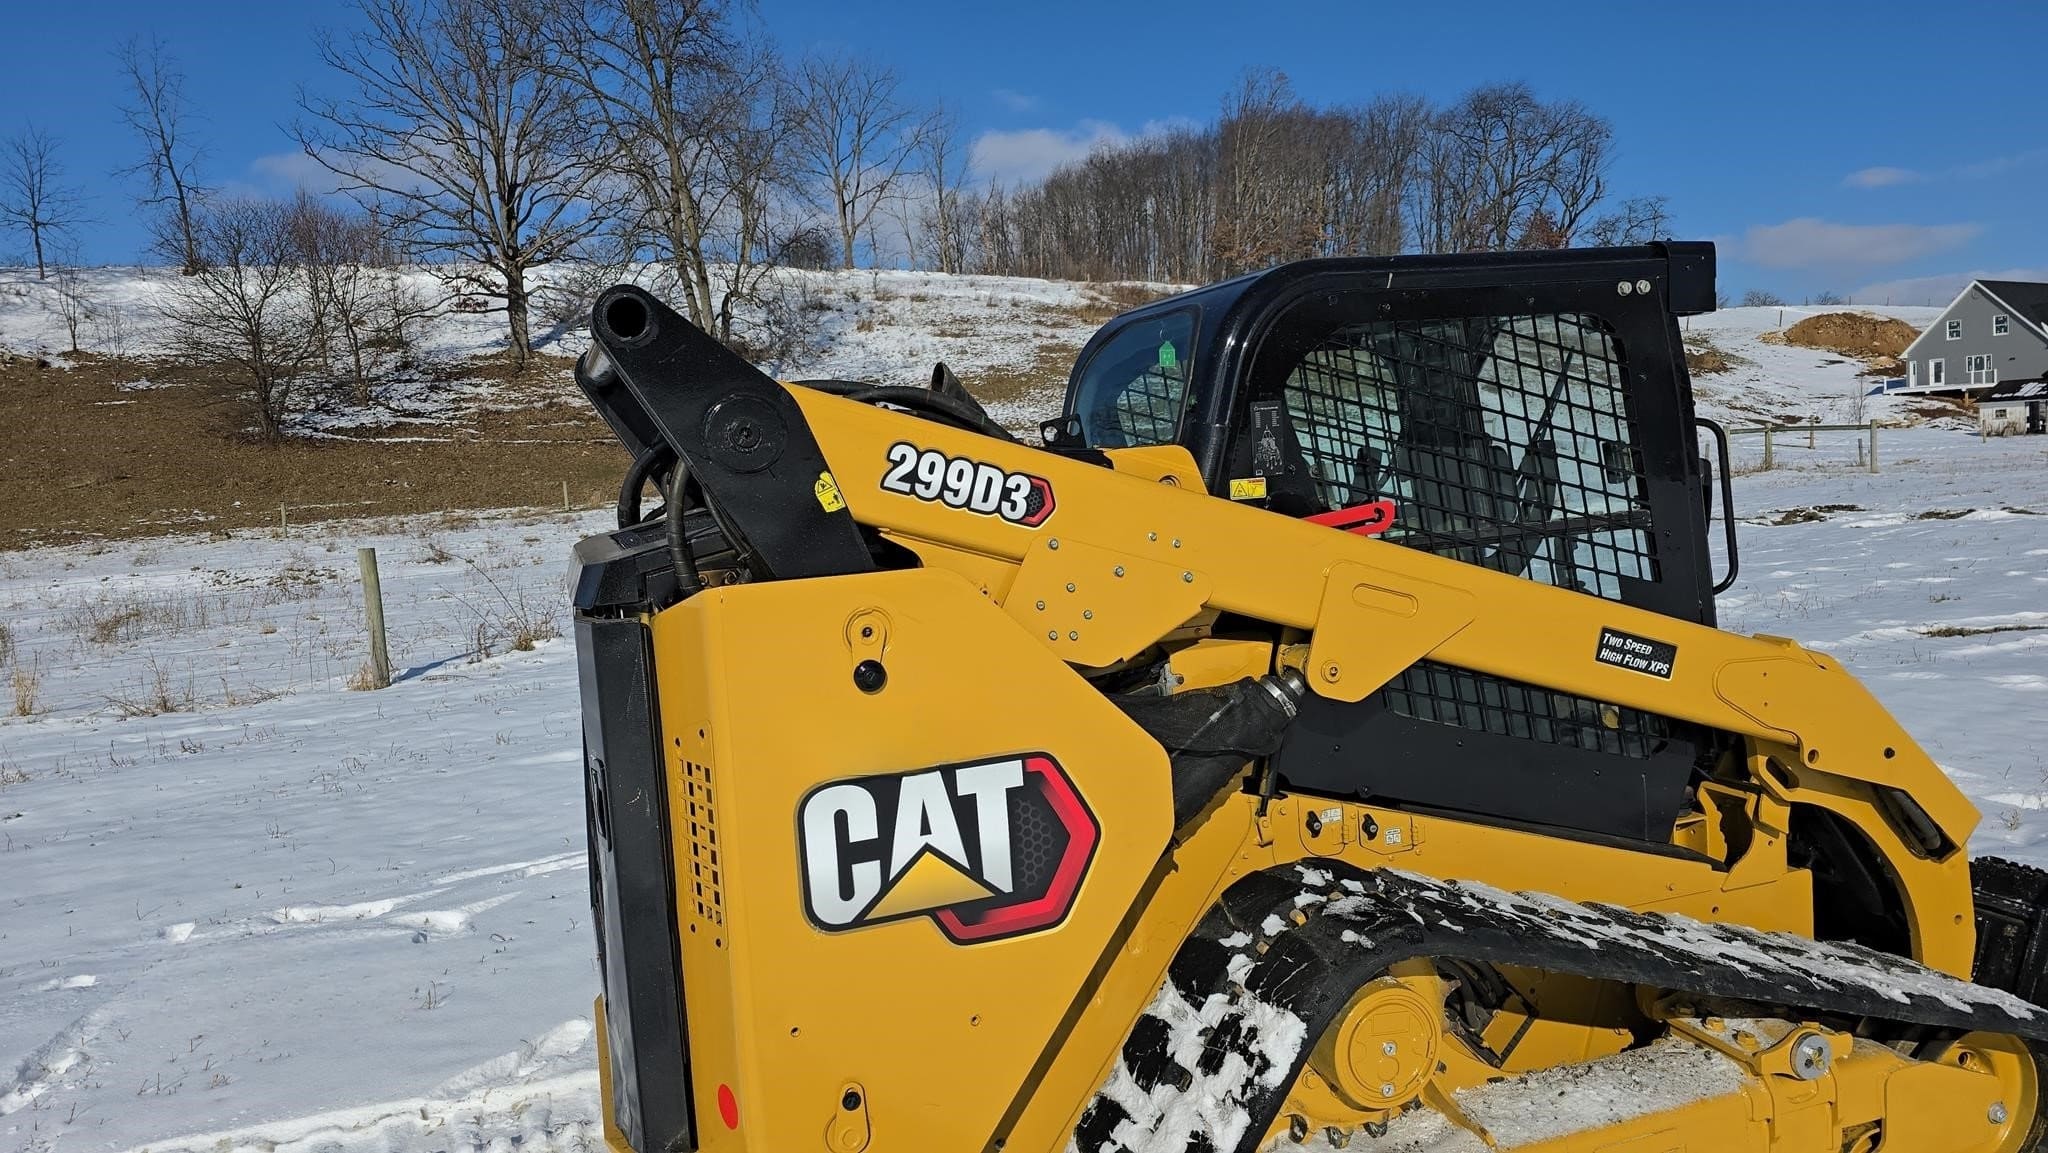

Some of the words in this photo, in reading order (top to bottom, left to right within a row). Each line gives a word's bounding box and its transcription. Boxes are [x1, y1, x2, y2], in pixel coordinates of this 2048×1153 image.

[883, 444, 1031, 520] 299D3
[1648, 661, 1669, 674] XPS
[804, 759, 1024, 925] CAT
